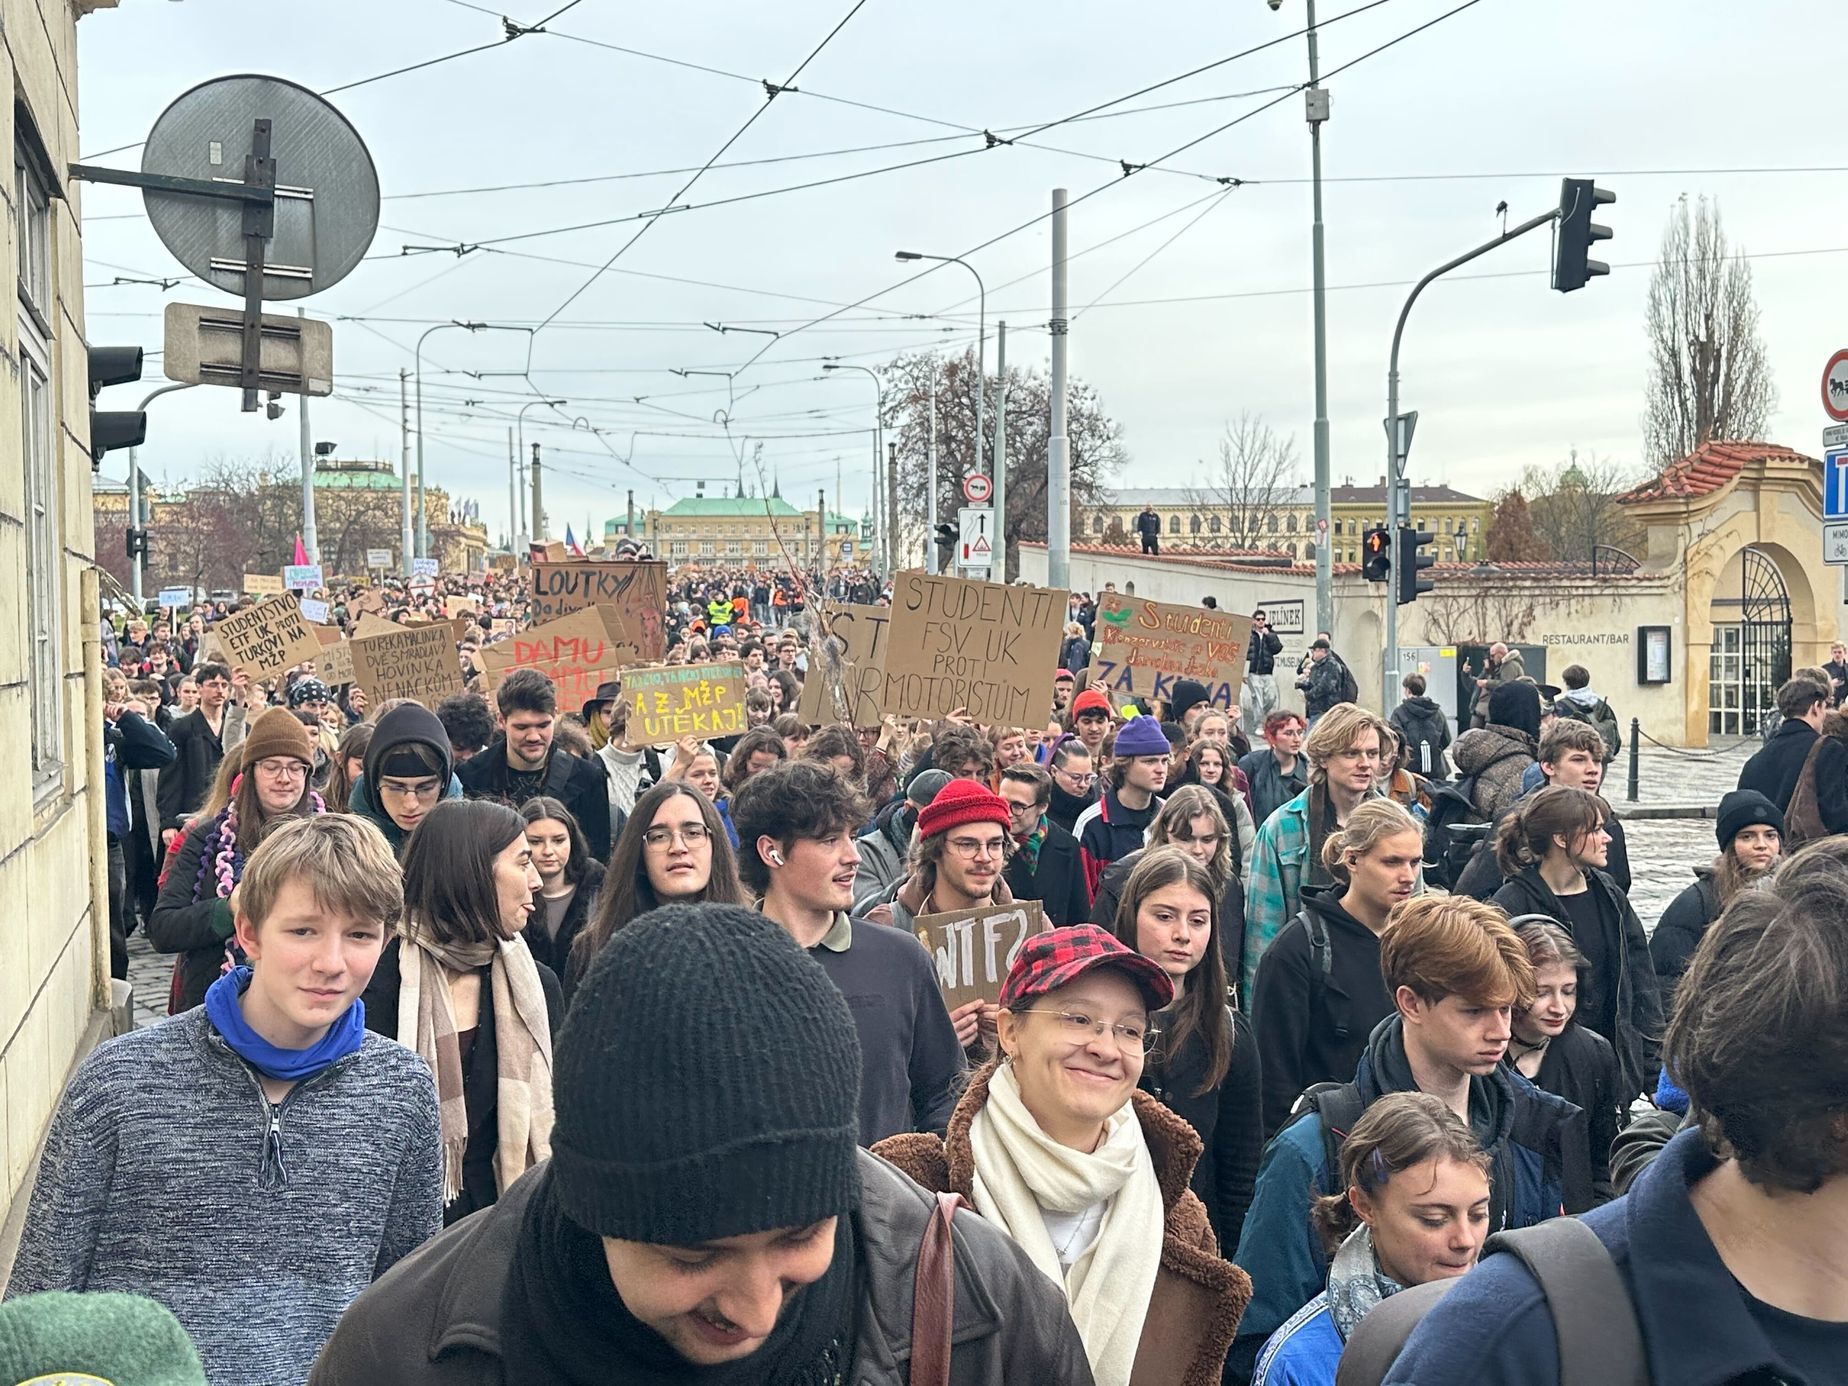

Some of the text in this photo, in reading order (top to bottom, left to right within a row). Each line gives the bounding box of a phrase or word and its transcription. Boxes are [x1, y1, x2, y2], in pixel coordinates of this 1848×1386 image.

[534, 568, 628, 598] LOUTKY
[220, 593, 297, 639] STUDENTSTVO
[905, 577, 1055, 629] STUDENTI
[1138, 601, 1233, 640] Studenti
[1269, 606, 1301, 625] JELÍNEK
[229, 612, 300, 650] ETF UK PROTI
[235, 625, 306, 664] TURKOVI NA
[921, 622, 1022, 665] FSV UK
[1542, 633, 1630, 646] RESTAURANT/BAR
[259, 649, 286, 671] MŽP
[513, 635, 604, 664] DAMU
[933, 654, 987, 677] PROTI
[1096, 660, 1134, 693] ZA
[636, 680, 727, 716] A Z MŽP
[884, 673, 1031, 722] MOTORISTŮM
[644, 702, 746, 737] UTEKAJ!
